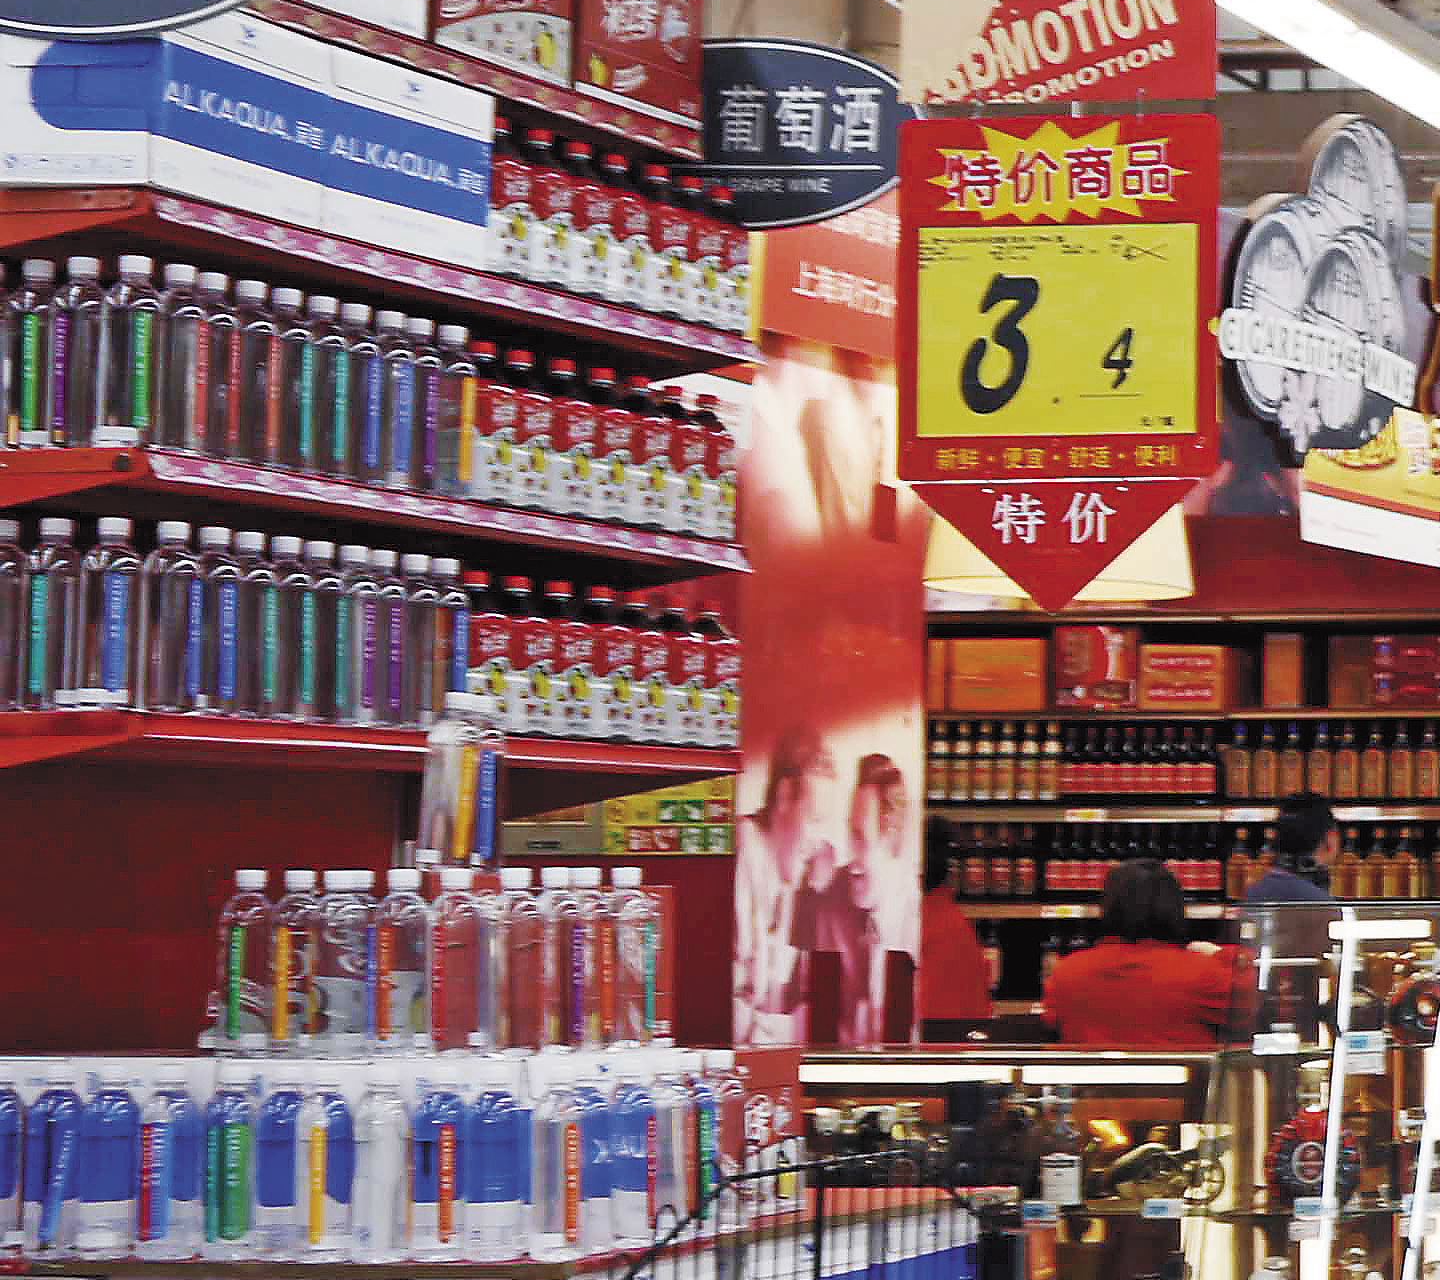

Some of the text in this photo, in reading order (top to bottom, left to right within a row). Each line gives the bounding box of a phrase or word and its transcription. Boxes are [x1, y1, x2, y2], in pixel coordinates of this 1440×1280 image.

[719, 83, 884, 153] 葡萄酒
[944, 143, 1177, 208] 特价商品
[961, 272, 1039, 414] 3
[1102, 327, 1132, 389] 4
[992, 491, 1117, 546] 特价
